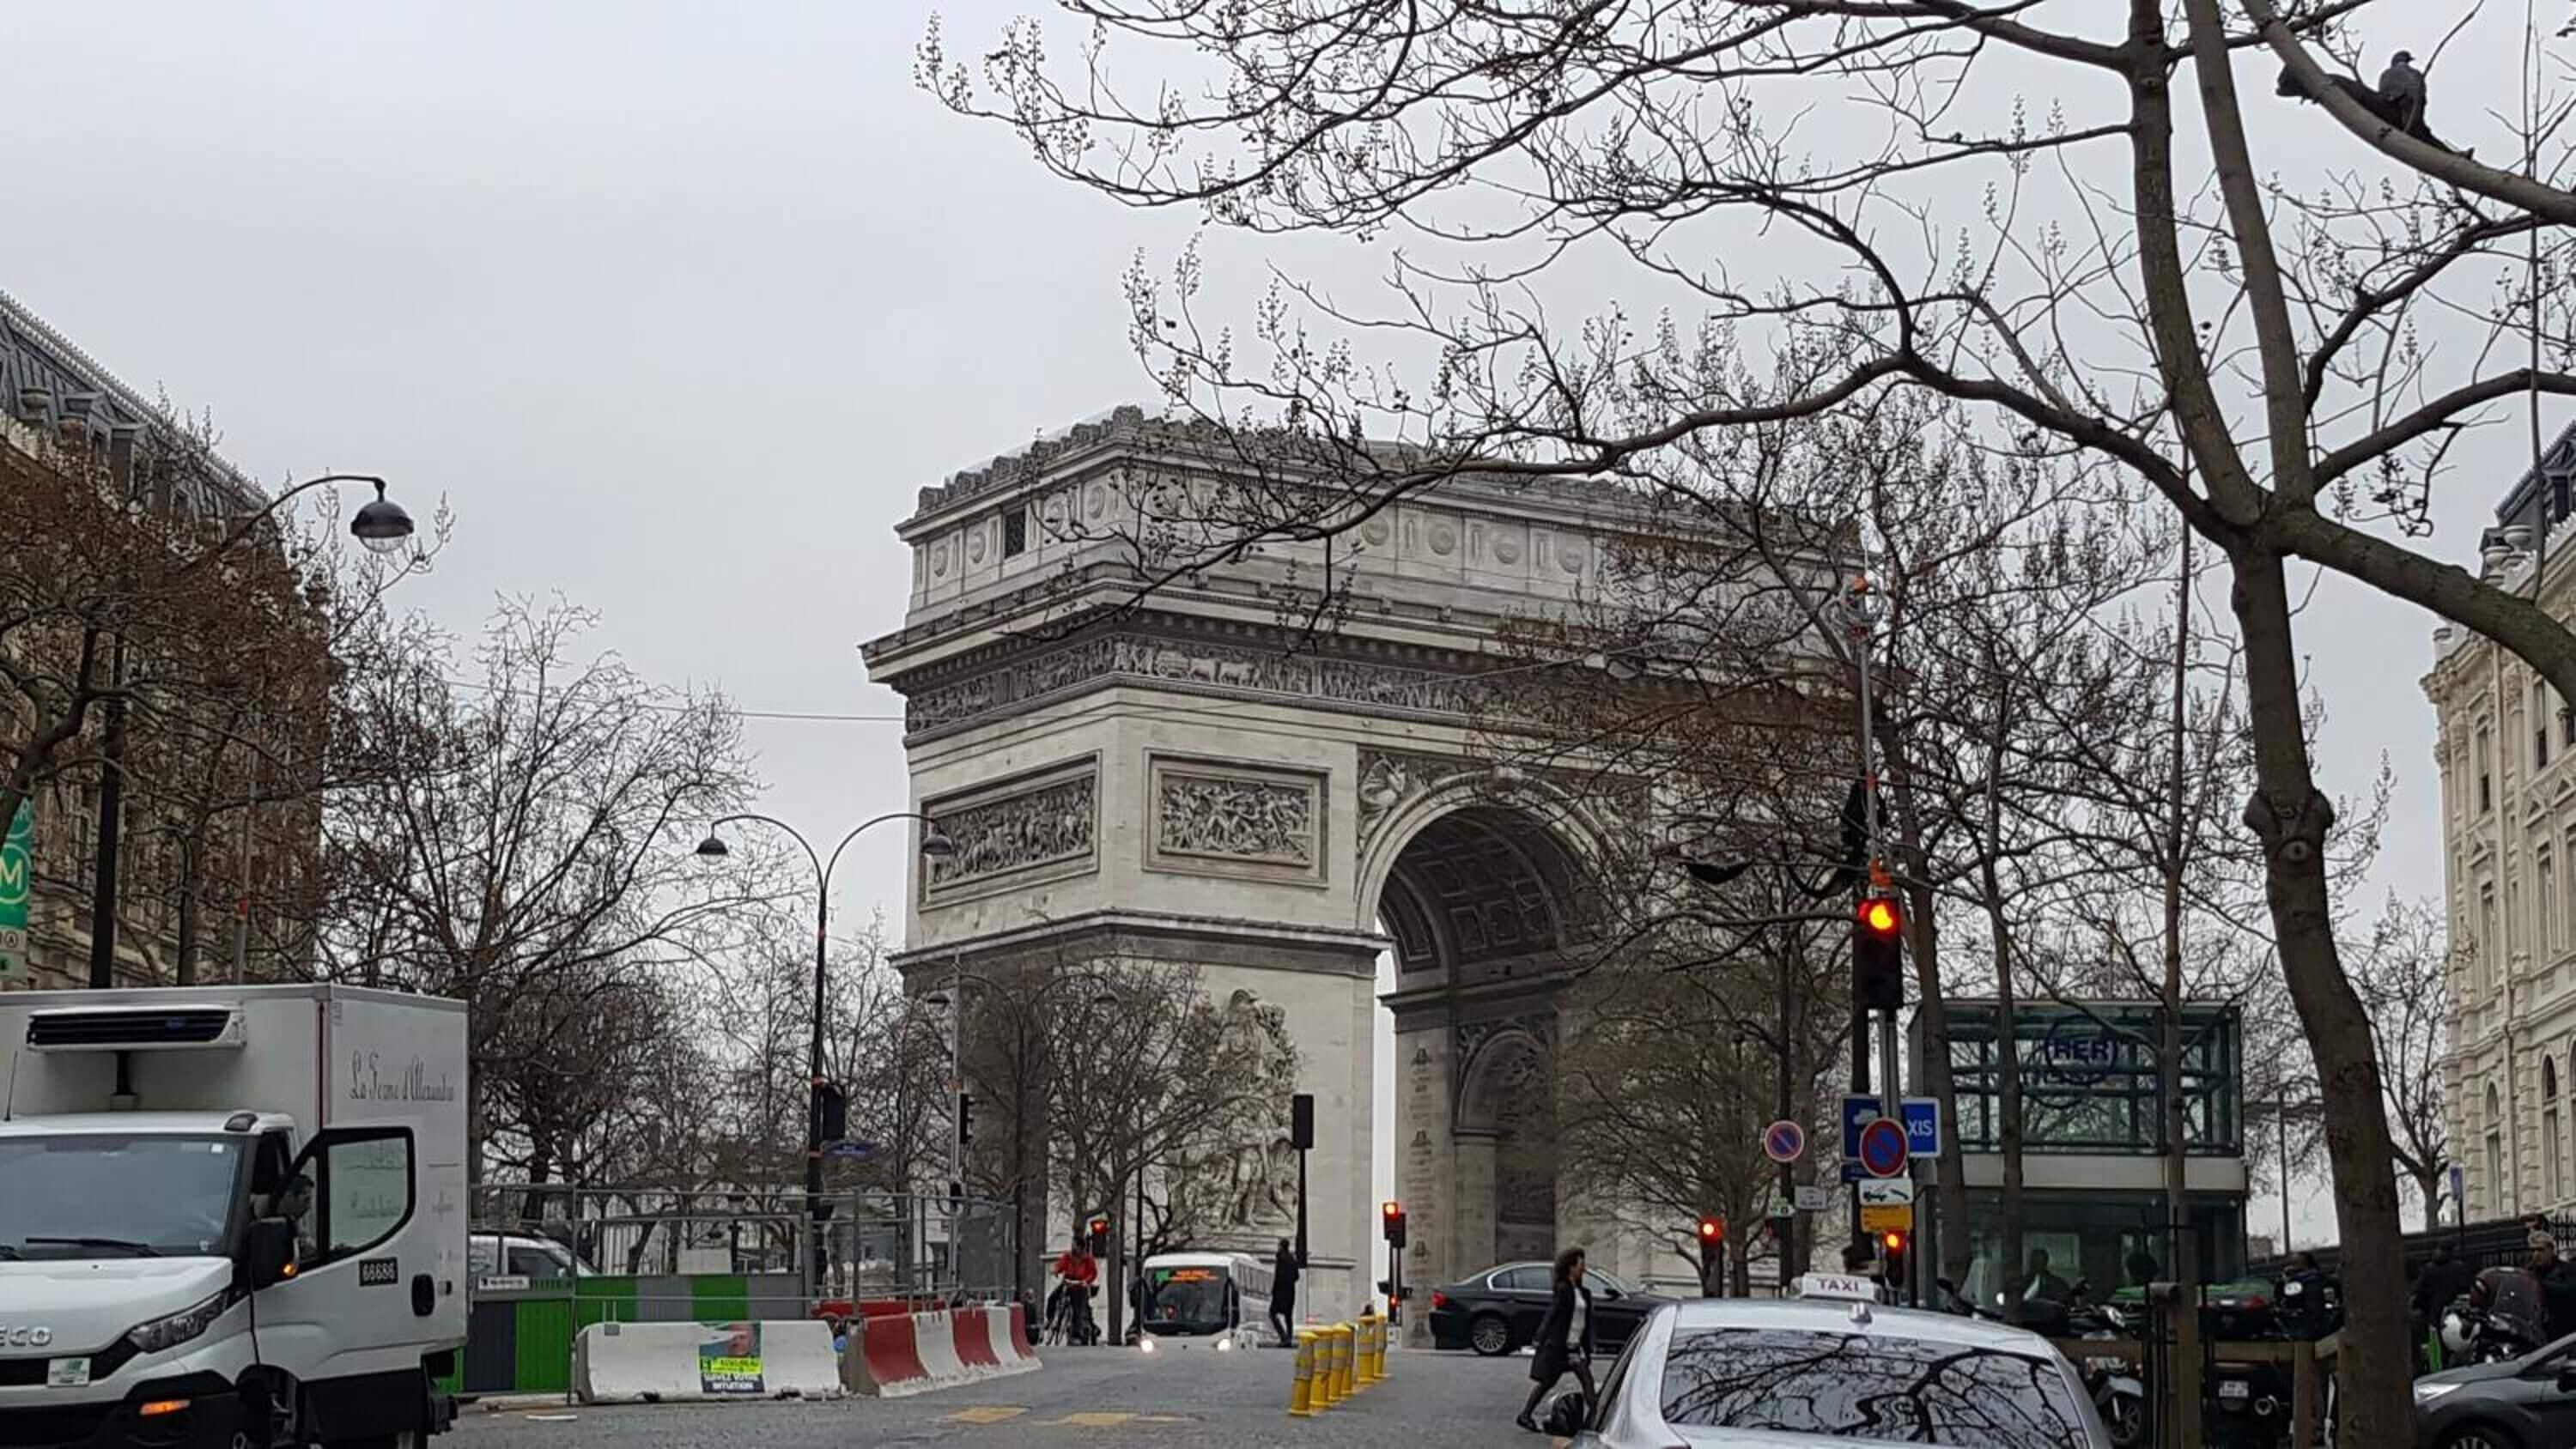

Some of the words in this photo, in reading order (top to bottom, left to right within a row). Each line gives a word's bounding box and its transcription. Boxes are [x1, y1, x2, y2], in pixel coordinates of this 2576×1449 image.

[2053, 1040, 2109, 1062] RER
[1907, 1119, 1932, 1137] XIS
[1817, 1276, 1859, 1292] TAXI
